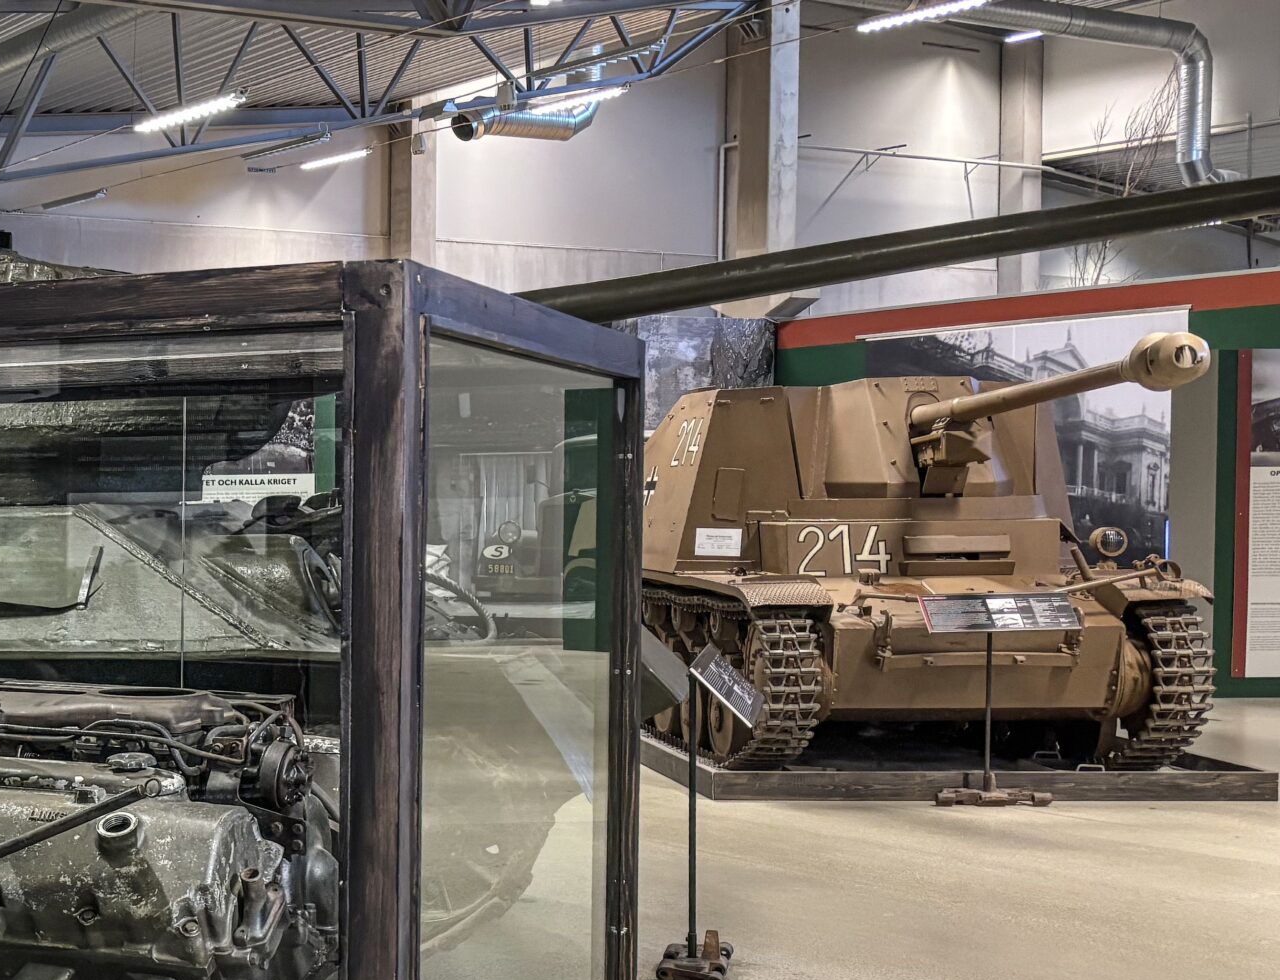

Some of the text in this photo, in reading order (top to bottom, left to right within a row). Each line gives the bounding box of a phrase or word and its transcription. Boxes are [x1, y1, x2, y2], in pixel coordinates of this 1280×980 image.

[670, 417, 704, 467] 214
[238, 478, 267, 486] KALLA
[490, 546, 504, 558] S
[797, 524, 892, 577] 214
